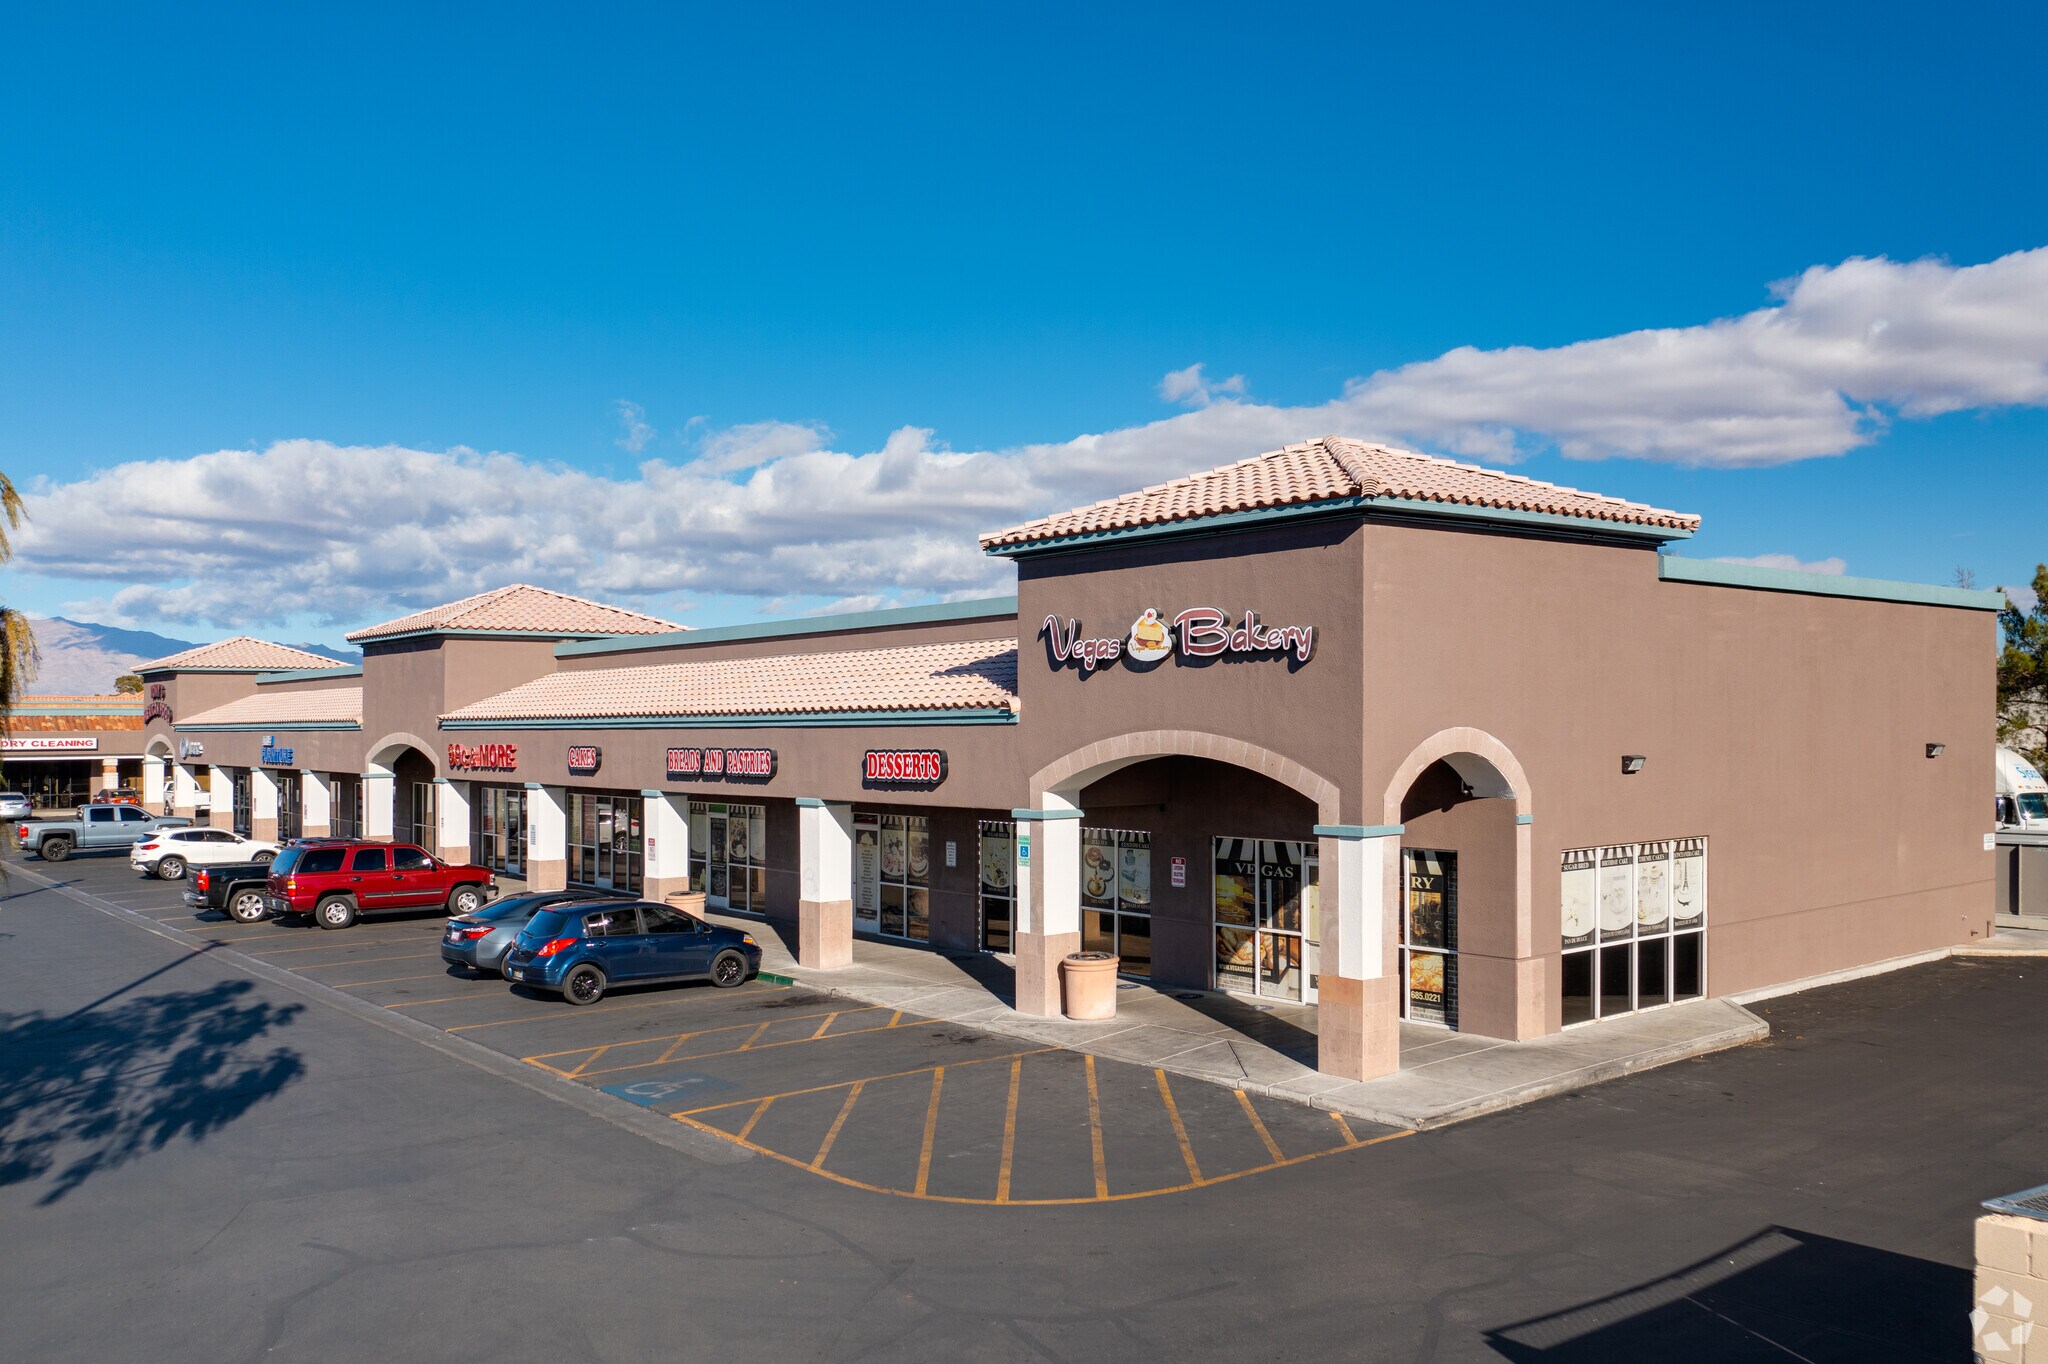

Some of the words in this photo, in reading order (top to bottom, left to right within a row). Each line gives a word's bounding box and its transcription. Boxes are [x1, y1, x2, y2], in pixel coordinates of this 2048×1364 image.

[1042, 614, 1120, 671] Vegas
[1174, 607, 1313, 662] Bakery
[31, 738, 94, 748] CLEANING
[479, 744, 516, 767] MORE
[568, 747, 597, 768] CAKES
[667, 749, 700, 772] BREADS
[703, 749, 724, 773] AND
[726, 750, 771, 775] PASTRIES
[867, 752, 940, 780] DESSERTS
[1235, 861, 1294, 879] VEGAS
[1563, 863, 1578, 871] SUGAR
[1410, 990, 1441, 1003] 685.0221
